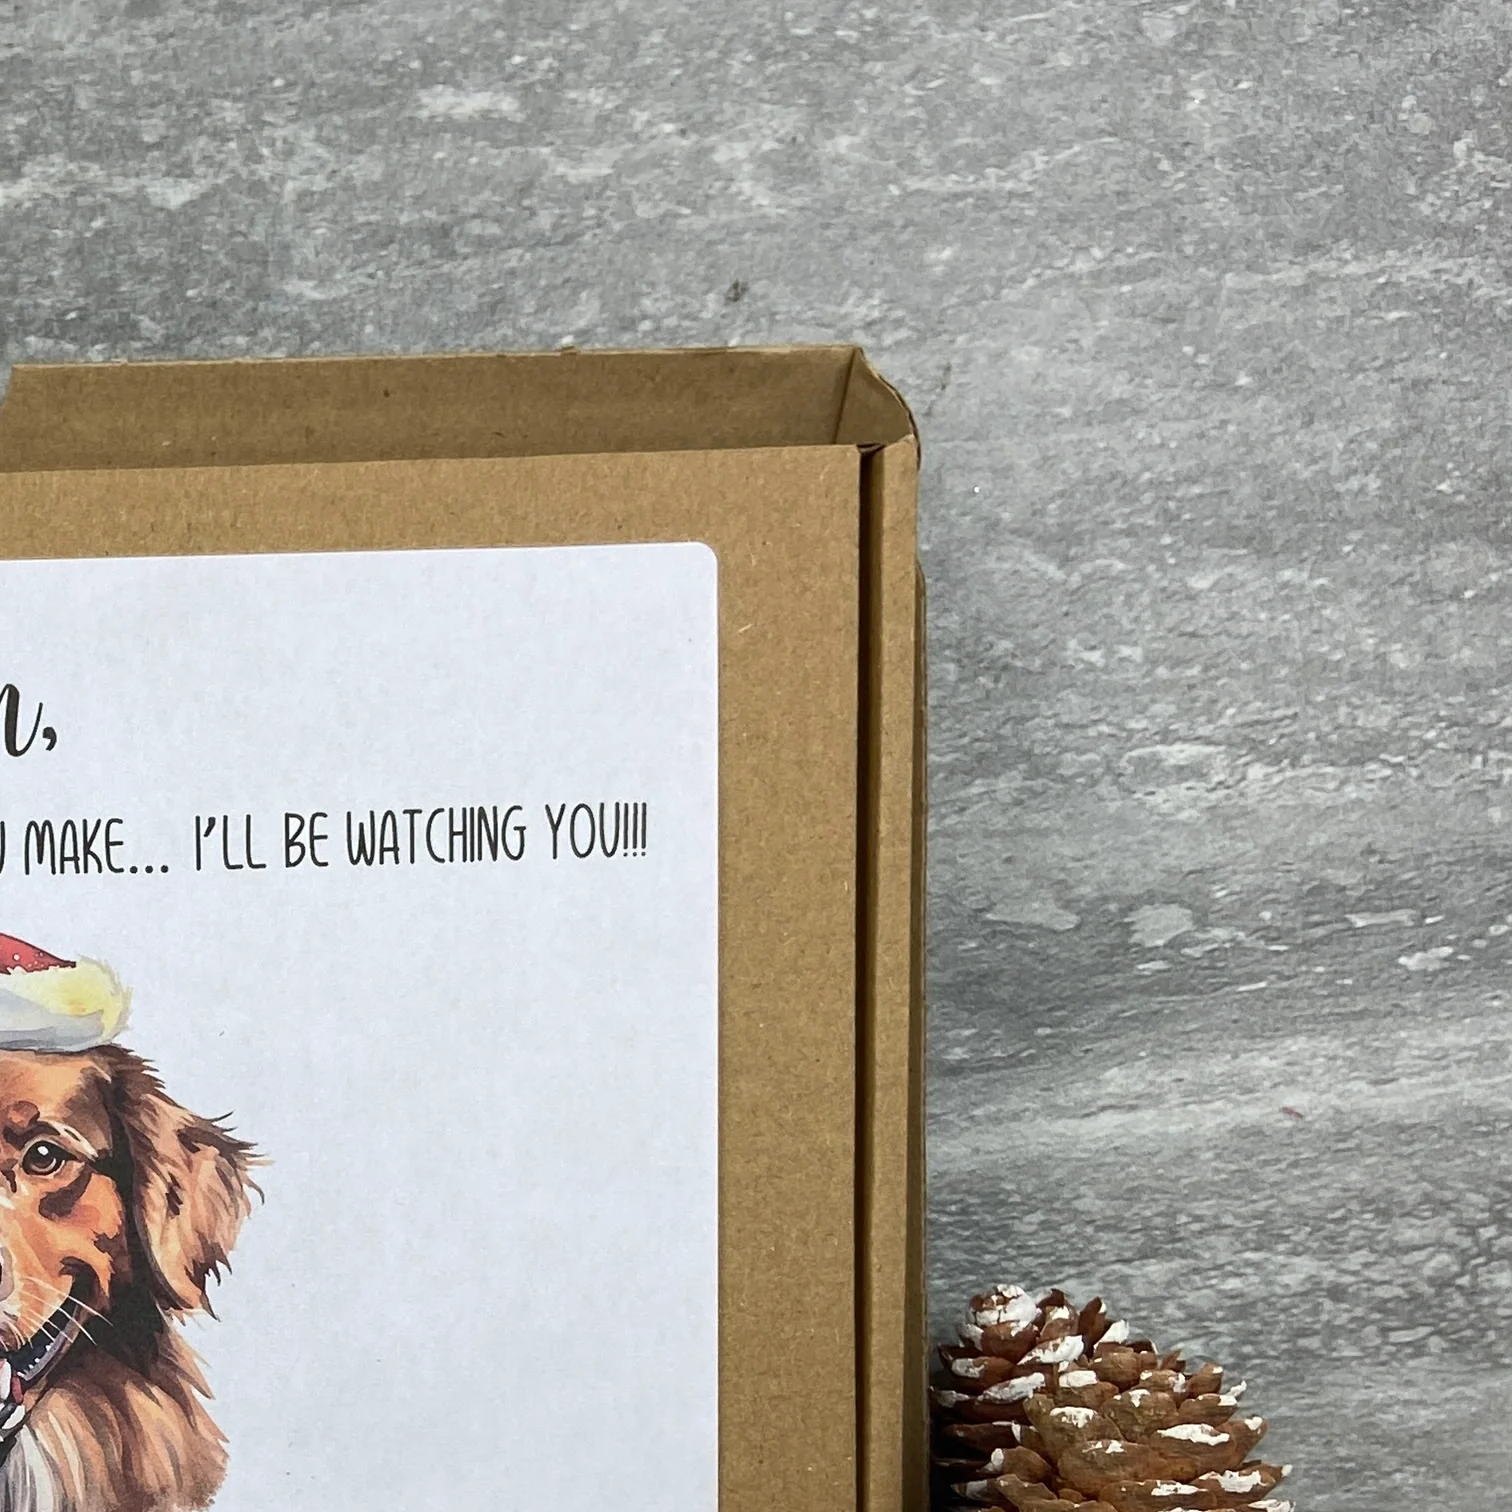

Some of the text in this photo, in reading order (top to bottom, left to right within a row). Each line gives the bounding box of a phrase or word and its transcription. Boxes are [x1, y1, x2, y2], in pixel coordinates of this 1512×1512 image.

[25, 819, 168, 875] MAKE...
[196, 815, 266, 870] I'LL
[285, 812, 328, 867] BE
[347, 806, 526, 866] WATCHING
[546, 802, 646, 859] YOU!!!
